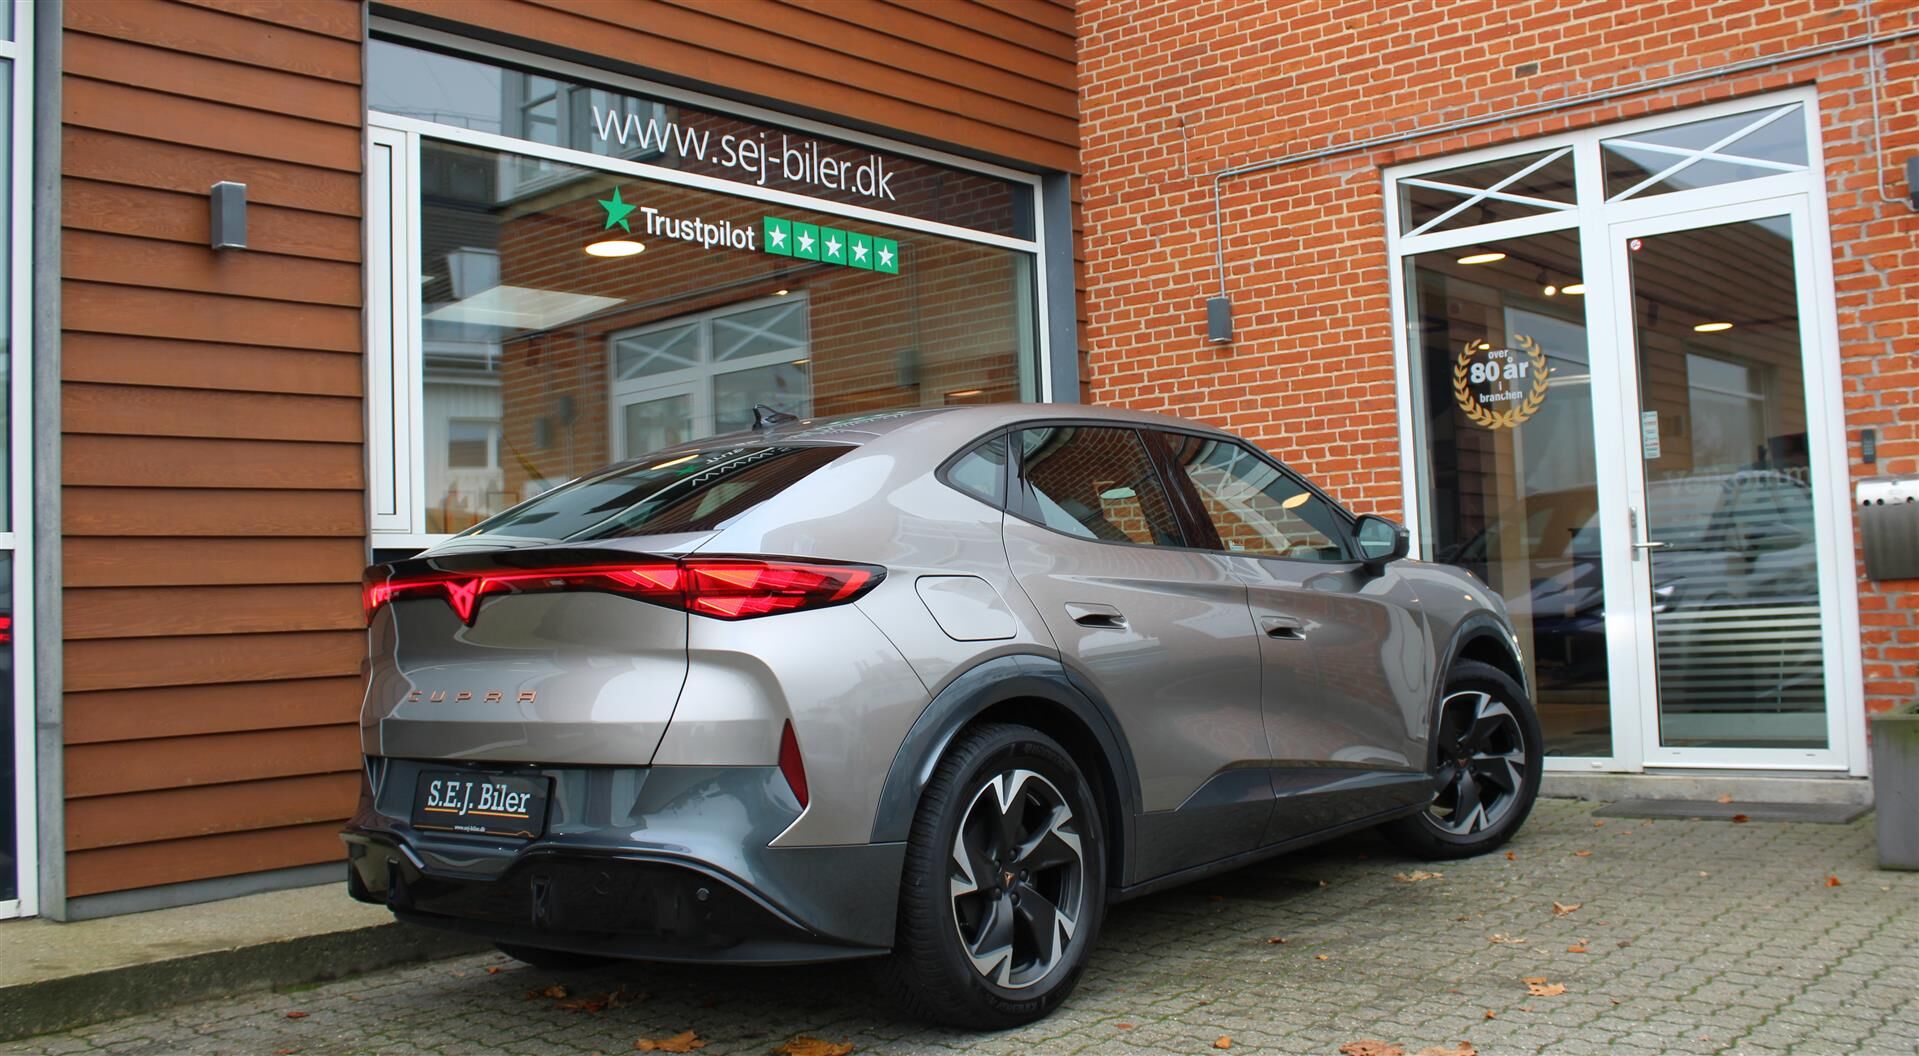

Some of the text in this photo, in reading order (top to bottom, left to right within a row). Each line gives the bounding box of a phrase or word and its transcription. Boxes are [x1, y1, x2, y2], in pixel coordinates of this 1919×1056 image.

[592, 105, 896, 200] www.sej-biler.dk
[640, 206, 755, 251] Trustpilot
[1488, 349, 1509, 360] over
[1470, 356, 1529, 384] 80 år
[1479, 389, 1523, 403] branchen
[408, 689, 537, 703] CUPRA
[427, 780, 530, 816] S.E.J. Biler
